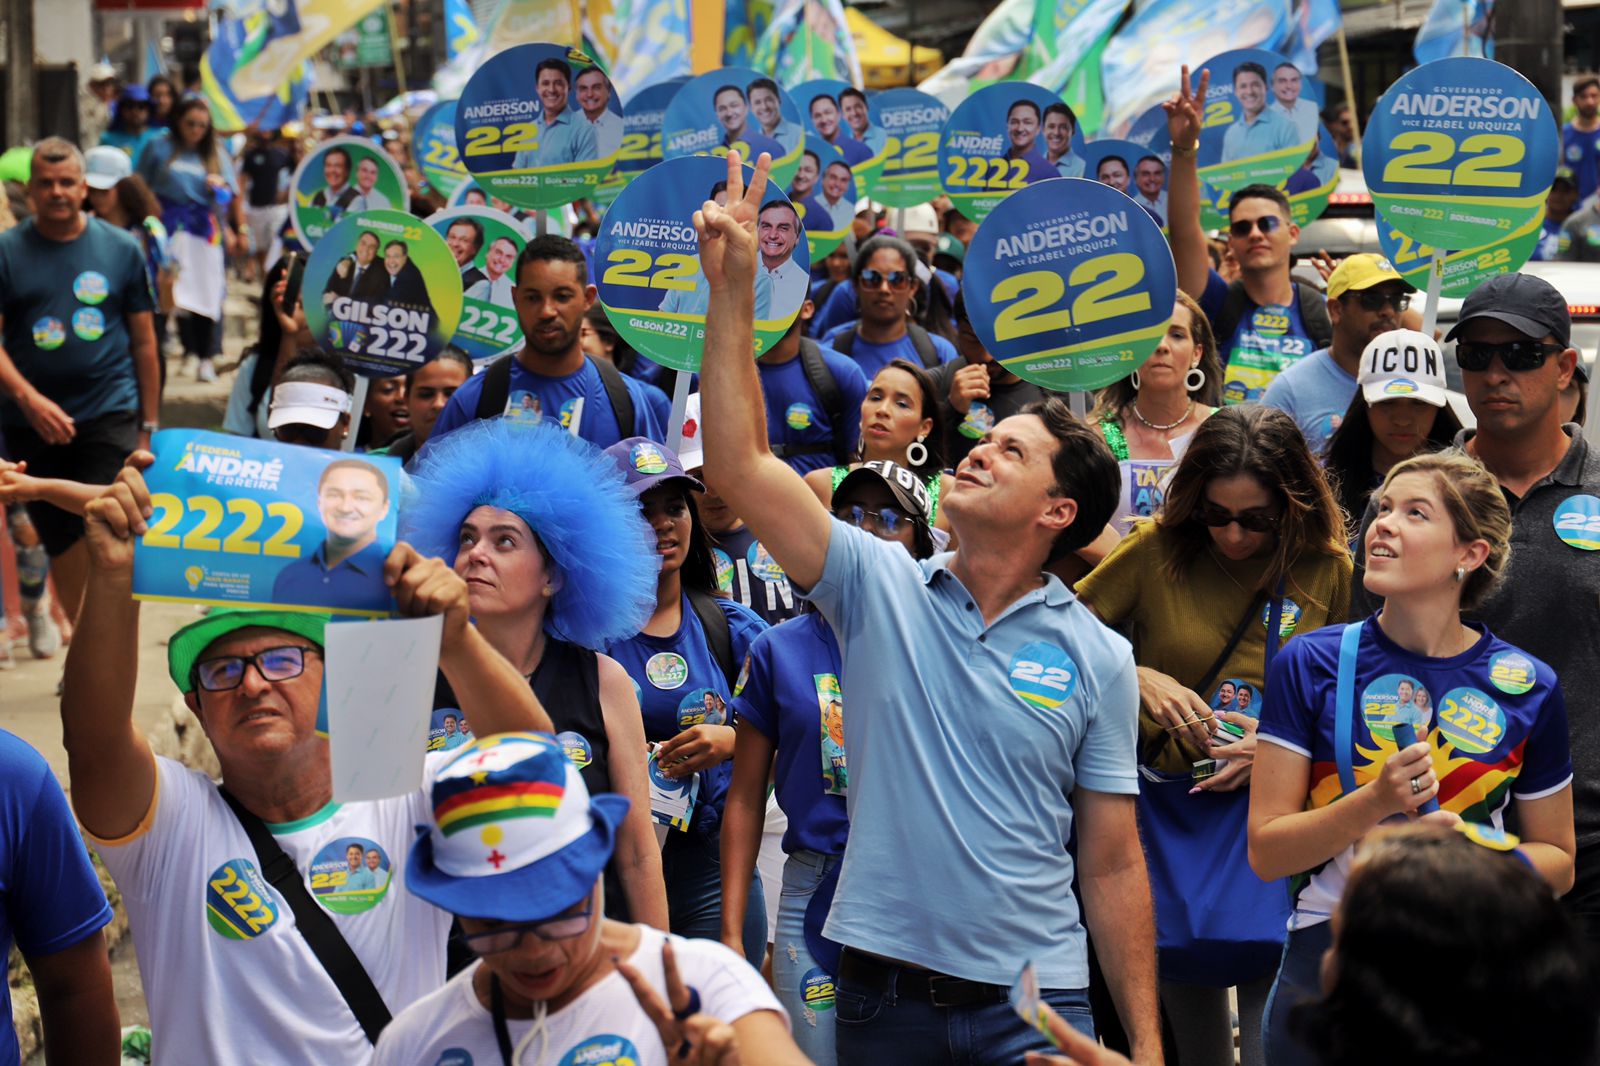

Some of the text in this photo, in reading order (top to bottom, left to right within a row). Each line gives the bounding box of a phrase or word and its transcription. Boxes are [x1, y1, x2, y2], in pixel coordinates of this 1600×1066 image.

[1433, 86, 1503, 95] GOVERNADOR
[464, 100, 540, 119] ANDERSON
[1390, 93, 1541, 120] ANDERSON
[881, 107, 947, 128] DERSON
[1423, 120, 1464, 130] IZABEL
[1468, 121, 1522, 132] URQUIZA
[465, 122, 539, 157] 22
[668, 124, 718, 150] ANDRÉ
[945, 134, 1004, 150] ANDRÉ
[1382, 131, 1526, 188] 22
[519, 176, 538, 186] 222
[584, 174, 598, 185] 22
[946, 156, 1030, 189] 2222
[639, 217, 684, 226] GOVERNADOR
[1026, 211, 1089, 230] GOVERNADOR
[1390, 205, 1444, 220] GILSON 222
[1450, 213, 1511, 230] BOLSONARO 22
[356, 218, 423, 240] BOLSONARO 22
[610, 221, 700, 243] ANDERSO
[995, 211, 1128, 260] ANDERSON
[631, 240, 660, 248] IZABEL
[661, 242, 696, 251] URQUIZA
[1008, 238, 1118, 268] VICE IZABEL URQUIZA
[602, 249, 700, 292] 22
[1443, 259, 1478, 275] DERSON
[1477, 248, 1511, 270] 22
[991, 253, 1151, 342] 22
[332, 296, 430, 334] GILSON
[1253, 314, 1289, 329] 2222
[459, 305, 518, 345] 222
[629, 318, 664, 332] GILSON
[664, 322, 688, 336] 222
[367, 327, 428, 362] 222
[1282, 339, 1304, 355] 22
[1025, 358, 1072, 372] GILSON 222
[1119, 350, 1134, 361] 22
[1371, 346, 1437, 376] ICON
[195, 444, 241, 458] FEDERAL
[175, 453, 284, 482] ANDRÉ
[206, 475, 278, 491] FERREIRA
[142, 492, 304, 558] 2222
[1555, 512, 1600, 532] 22
[667, 671, 683, 680] 222
[1010, 661, 1071, 691] 22
[1491, 667, 1528, 682] 22
[681, 706, 706, 714] ANDERSON
[1365, 703, 1397, 716] 22
[1461, 695, 1497, 719] ANDRÉ
[680, 714, 705, 726] 22
[1439, 698, 1502, 745] 2222
[311, 861, 348, 872] ANDERSON
[311, 871, 348, 888] 22
[210, 866, 274, 934] 2222
[805, 983, 835, 1000] 22
